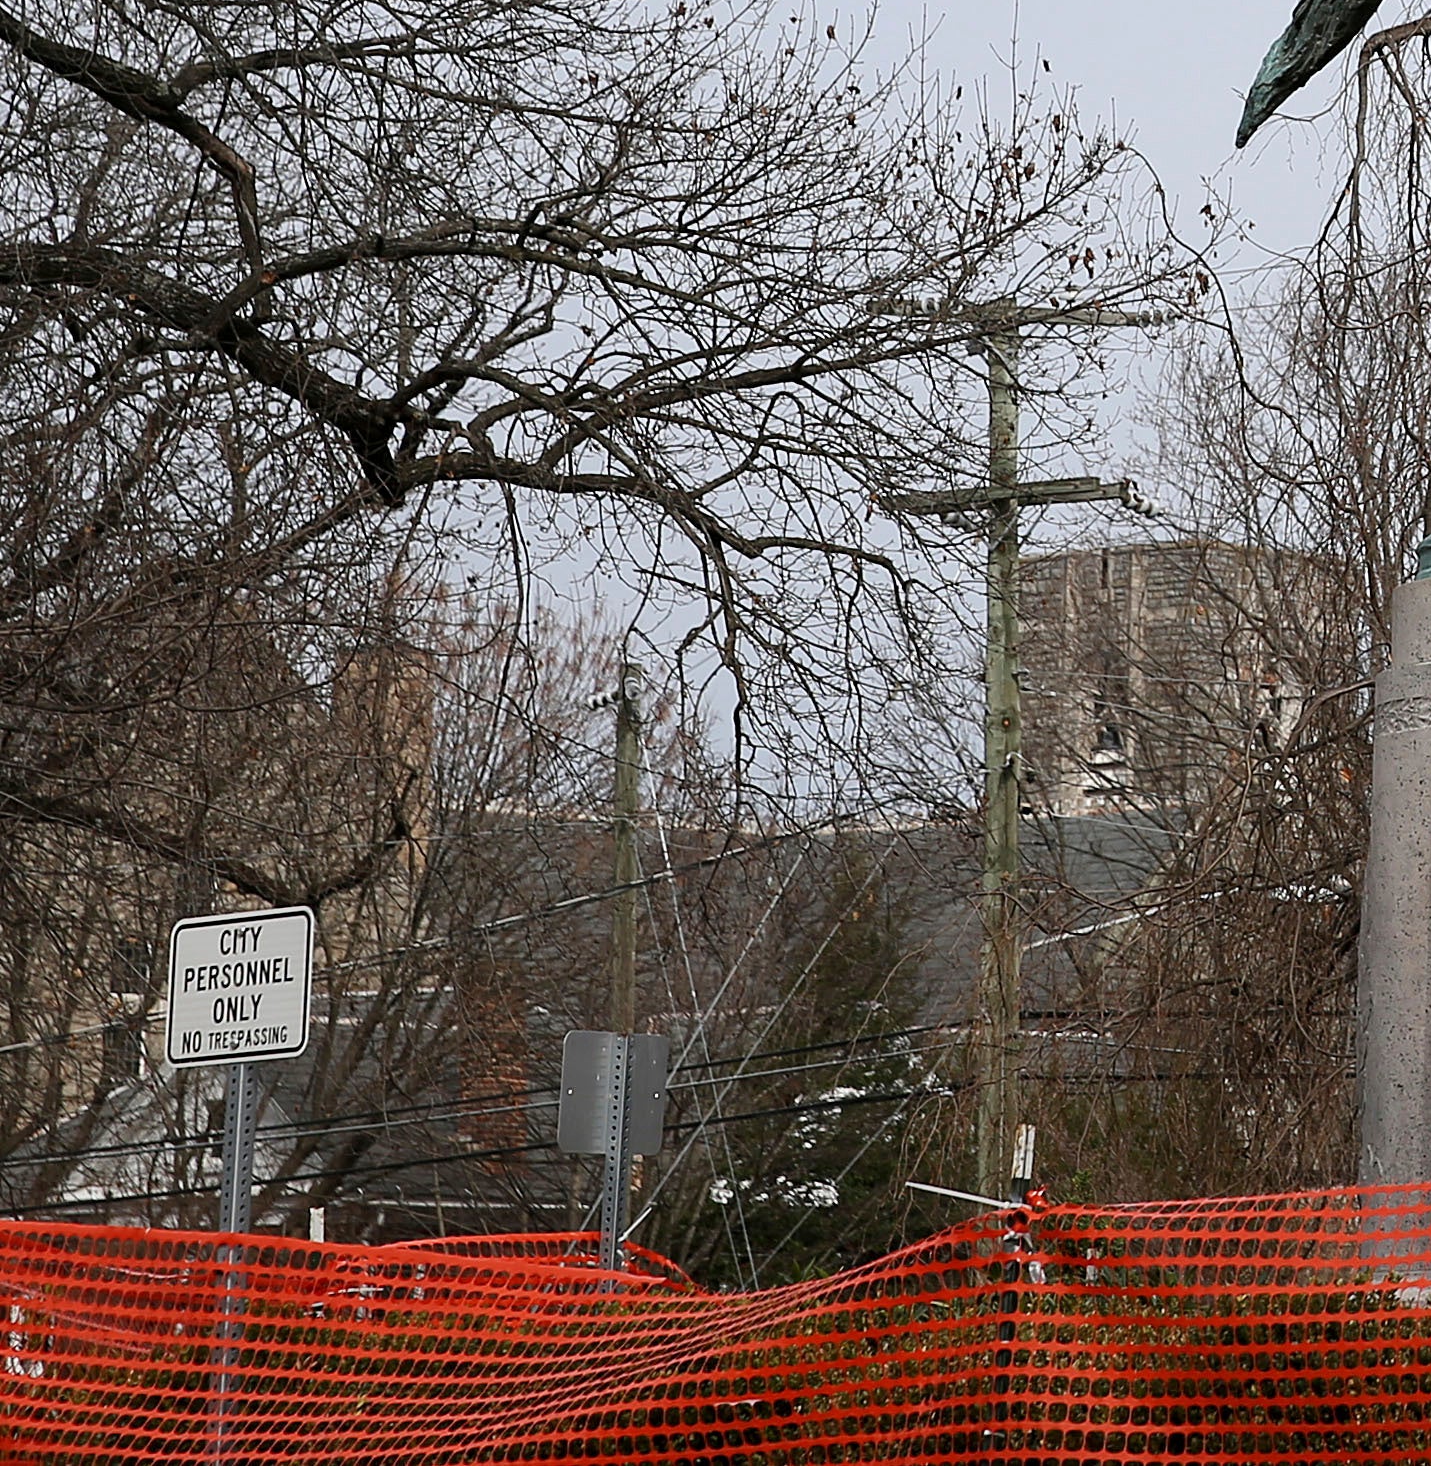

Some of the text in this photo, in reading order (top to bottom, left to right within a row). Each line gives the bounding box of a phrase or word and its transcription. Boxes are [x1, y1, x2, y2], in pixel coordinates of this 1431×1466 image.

[220, 925, 262, 955] CITY
[183, 957, 294, 992] PERSONNEL
[213, 993, 263, 1024] ONLY
[181, 1026, 288, 1054] NO TRESPASSING
